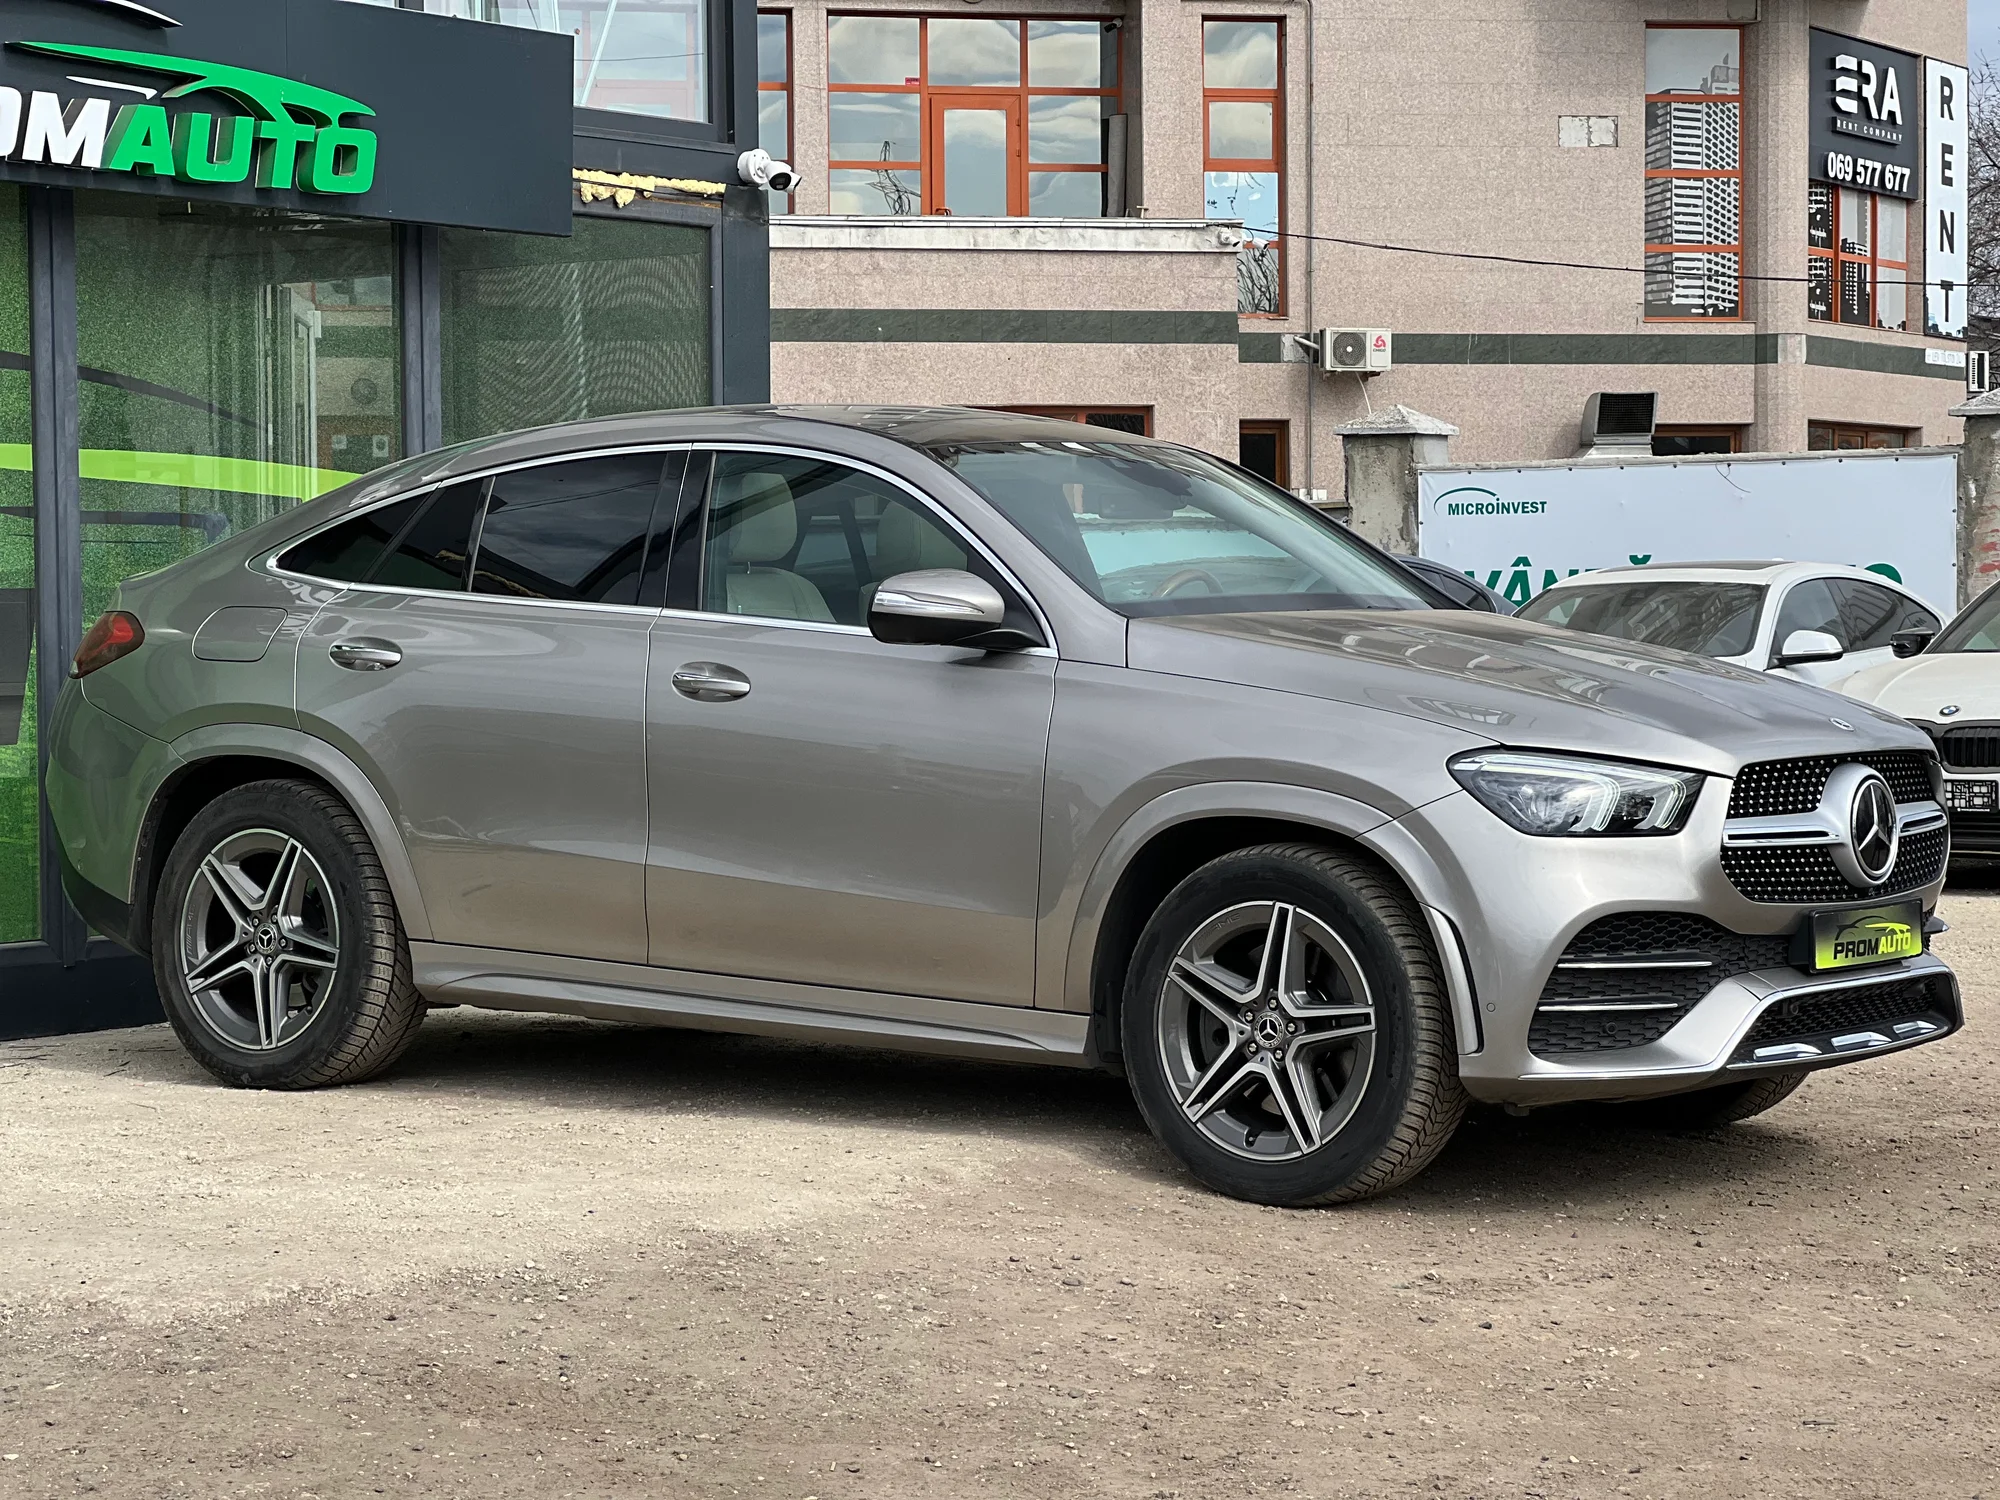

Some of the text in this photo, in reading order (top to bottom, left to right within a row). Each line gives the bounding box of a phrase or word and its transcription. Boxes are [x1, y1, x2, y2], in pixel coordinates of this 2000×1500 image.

[1835, 54, 1903, 125] ERA
[0, 86, 377, 194] MAUTO
[1836, 119, 1902, 142] RENT COMPANY
[1827, 151, 1911, 193] 069 577 677
[1939, 75, 1955, 323] RENT
[1833, 931, 1911, 961] PROMAUTO
